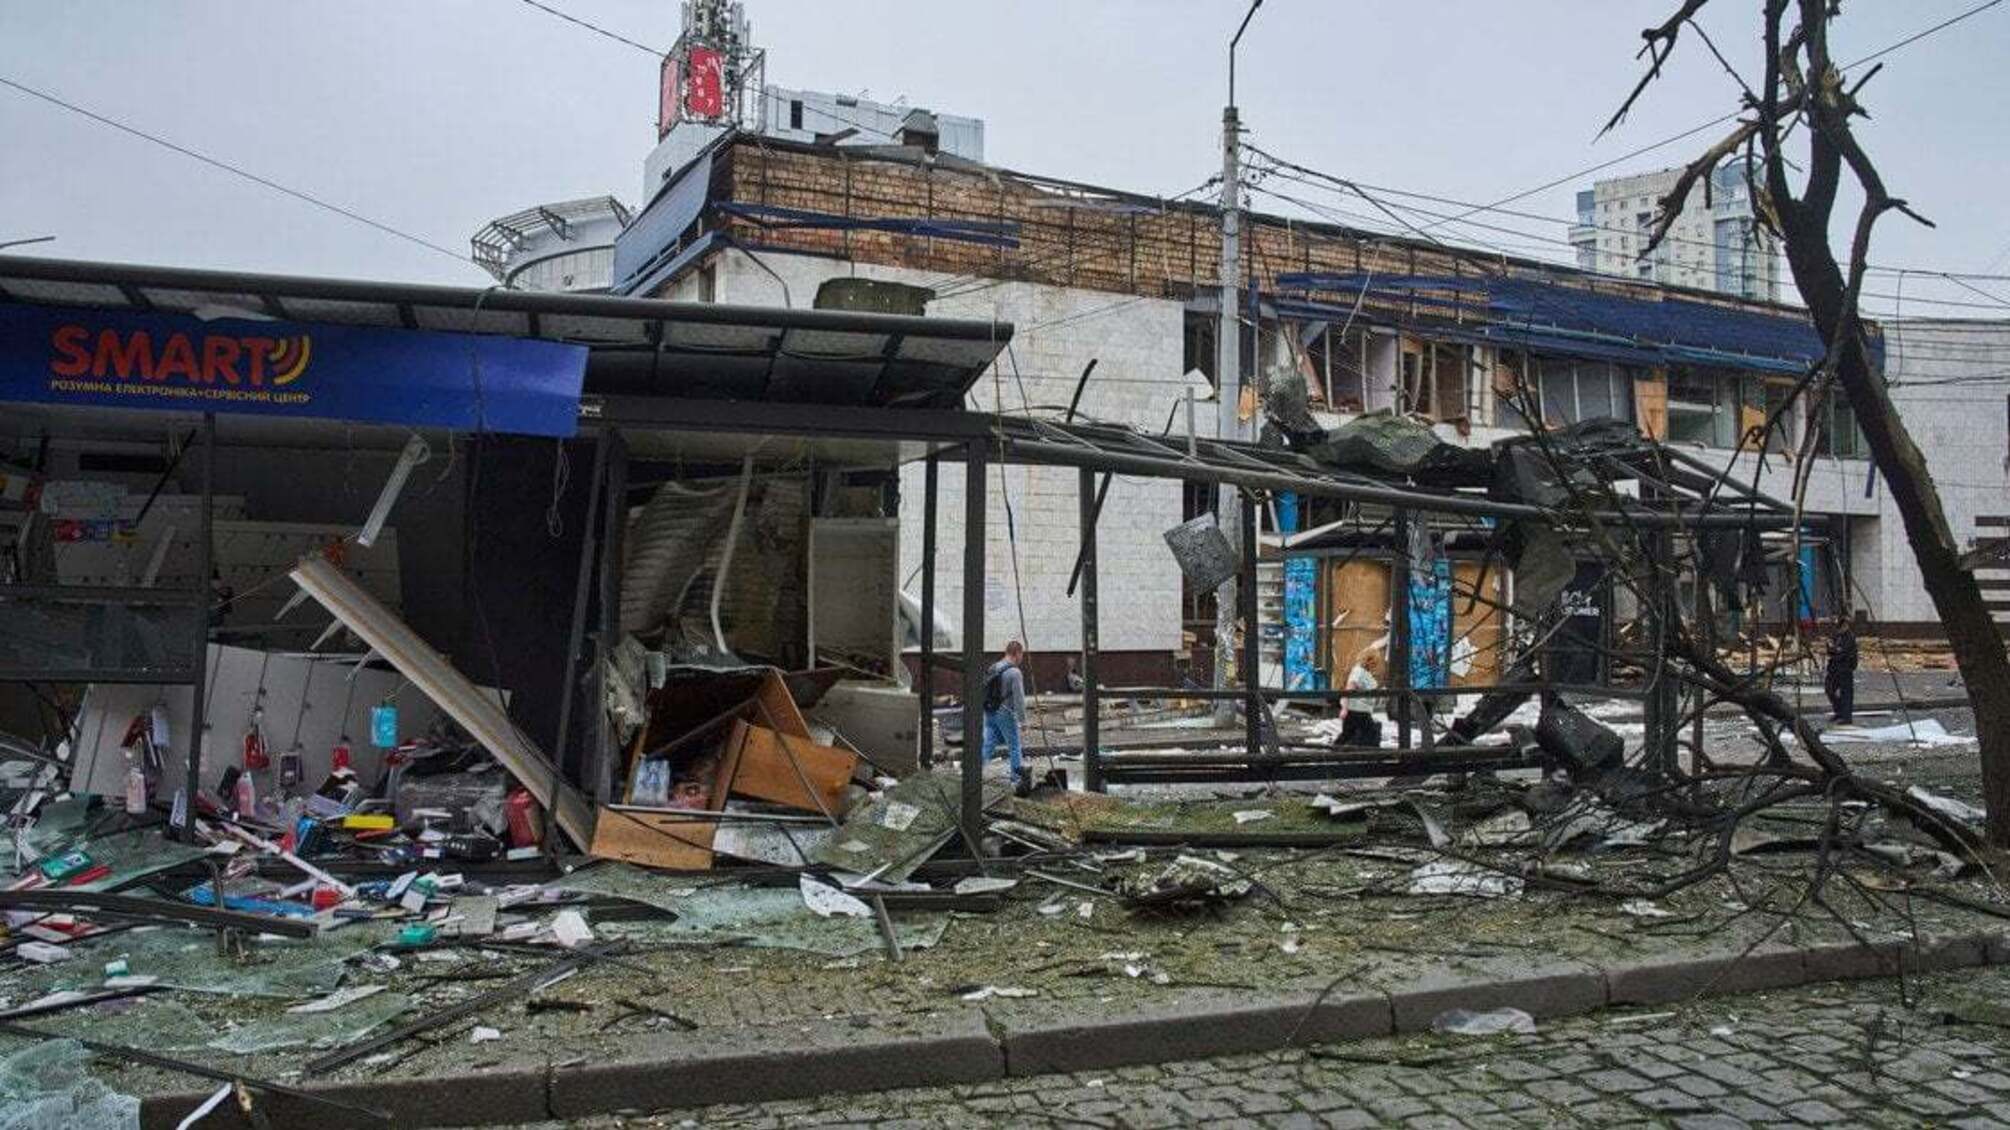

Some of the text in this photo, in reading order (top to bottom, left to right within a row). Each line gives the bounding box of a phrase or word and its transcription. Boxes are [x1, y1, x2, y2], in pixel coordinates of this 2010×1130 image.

[52, 324, 275, 385] SMART
[51, 379, 112, 393] РОЗУМНА
[273, 391, 312, 404] ЦЕНТР
